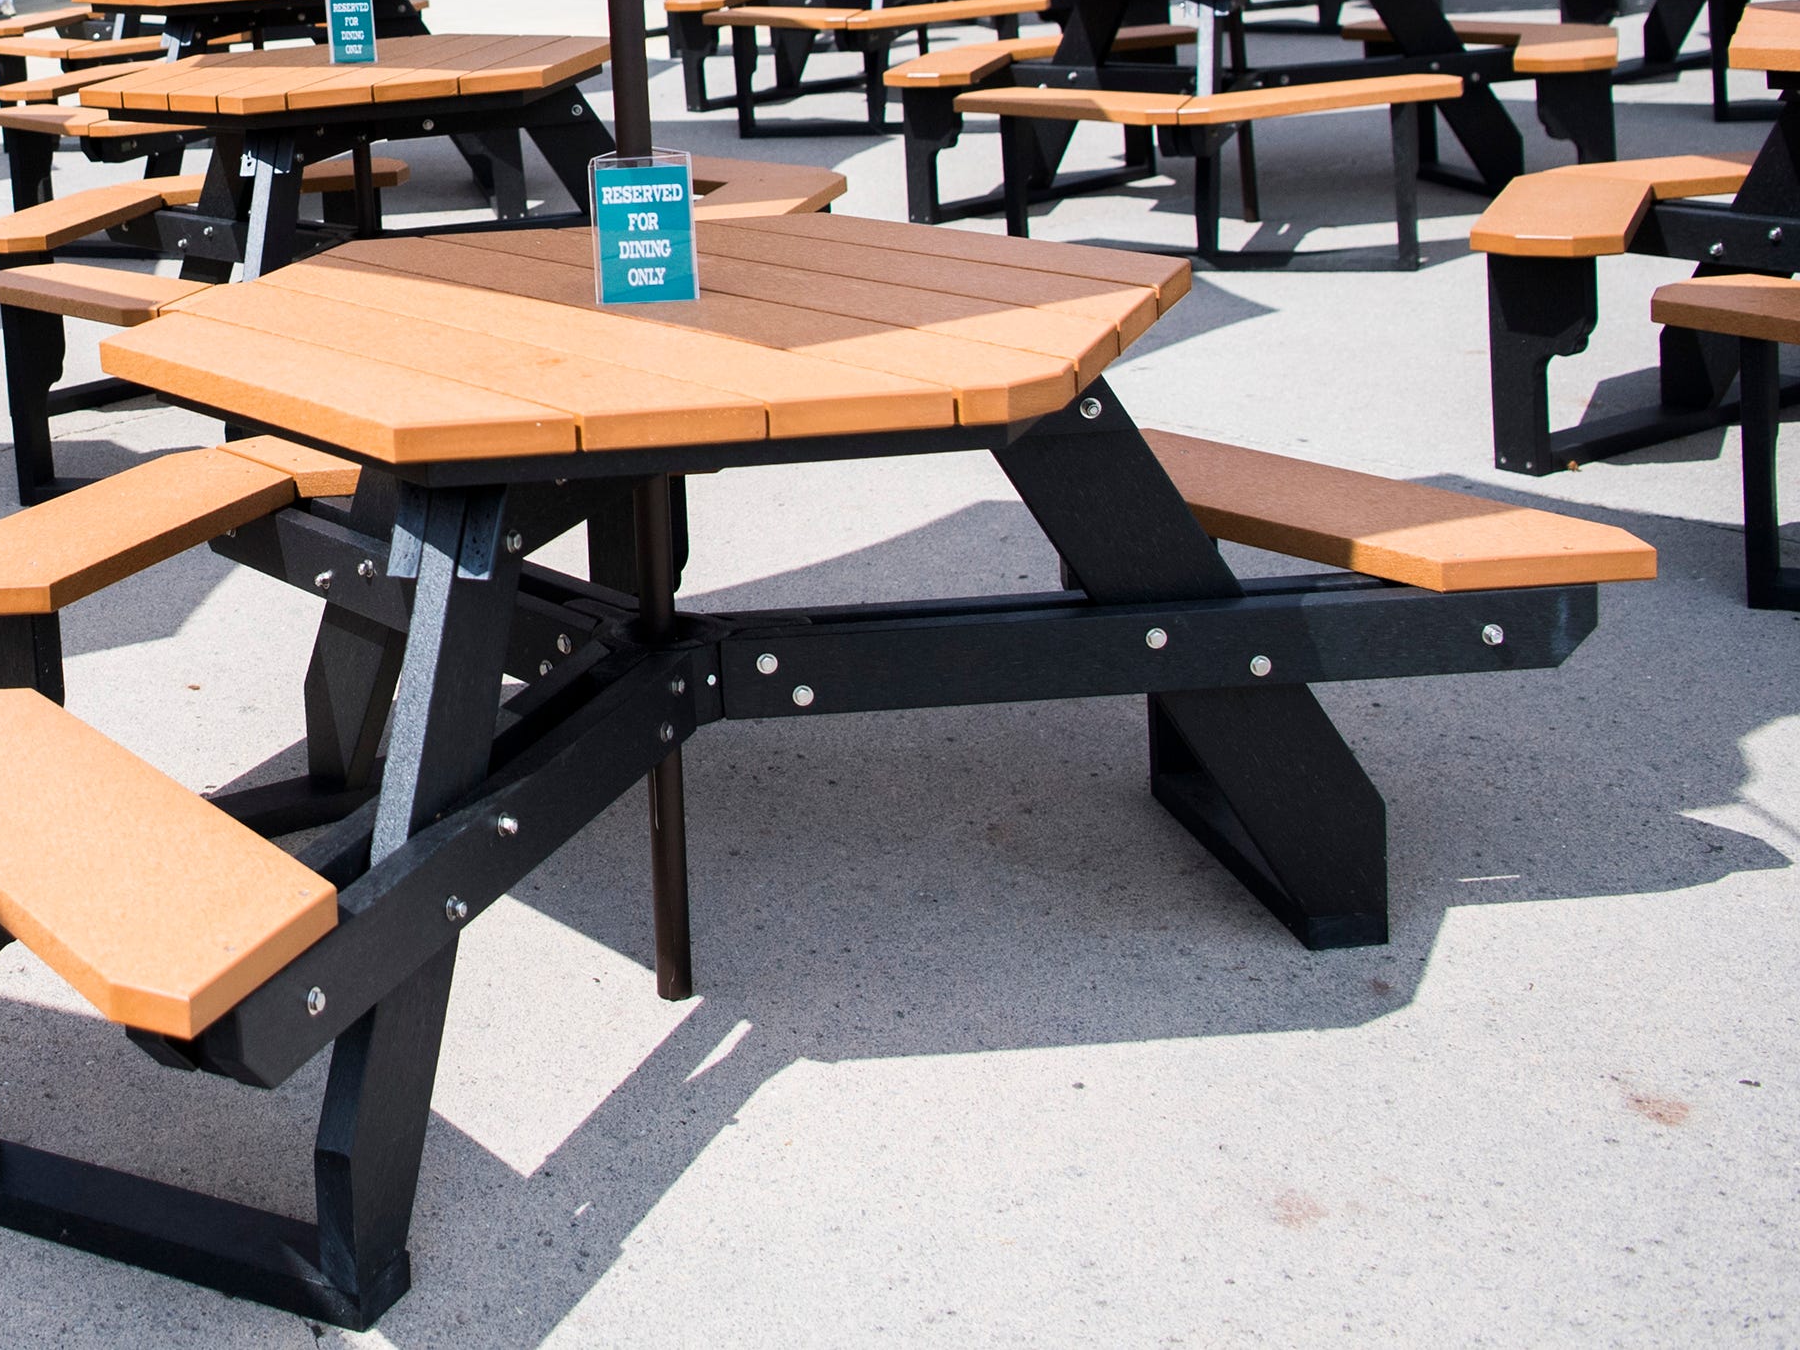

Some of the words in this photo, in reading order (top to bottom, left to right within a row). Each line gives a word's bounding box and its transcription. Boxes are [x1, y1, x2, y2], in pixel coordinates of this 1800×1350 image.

[332, 2, 370, 13] RESERVED
[344, 16, 359, 27] FOR
[340, 30, 365, 41] DINING
[344, 43, 363, 55] ONLY
[601, 183, 683, 205] RESERVED
[627, 212, 659, 231] FOR
[618, 239, 672, 259] DINING
[627, 267, 667, 287] ONLY
